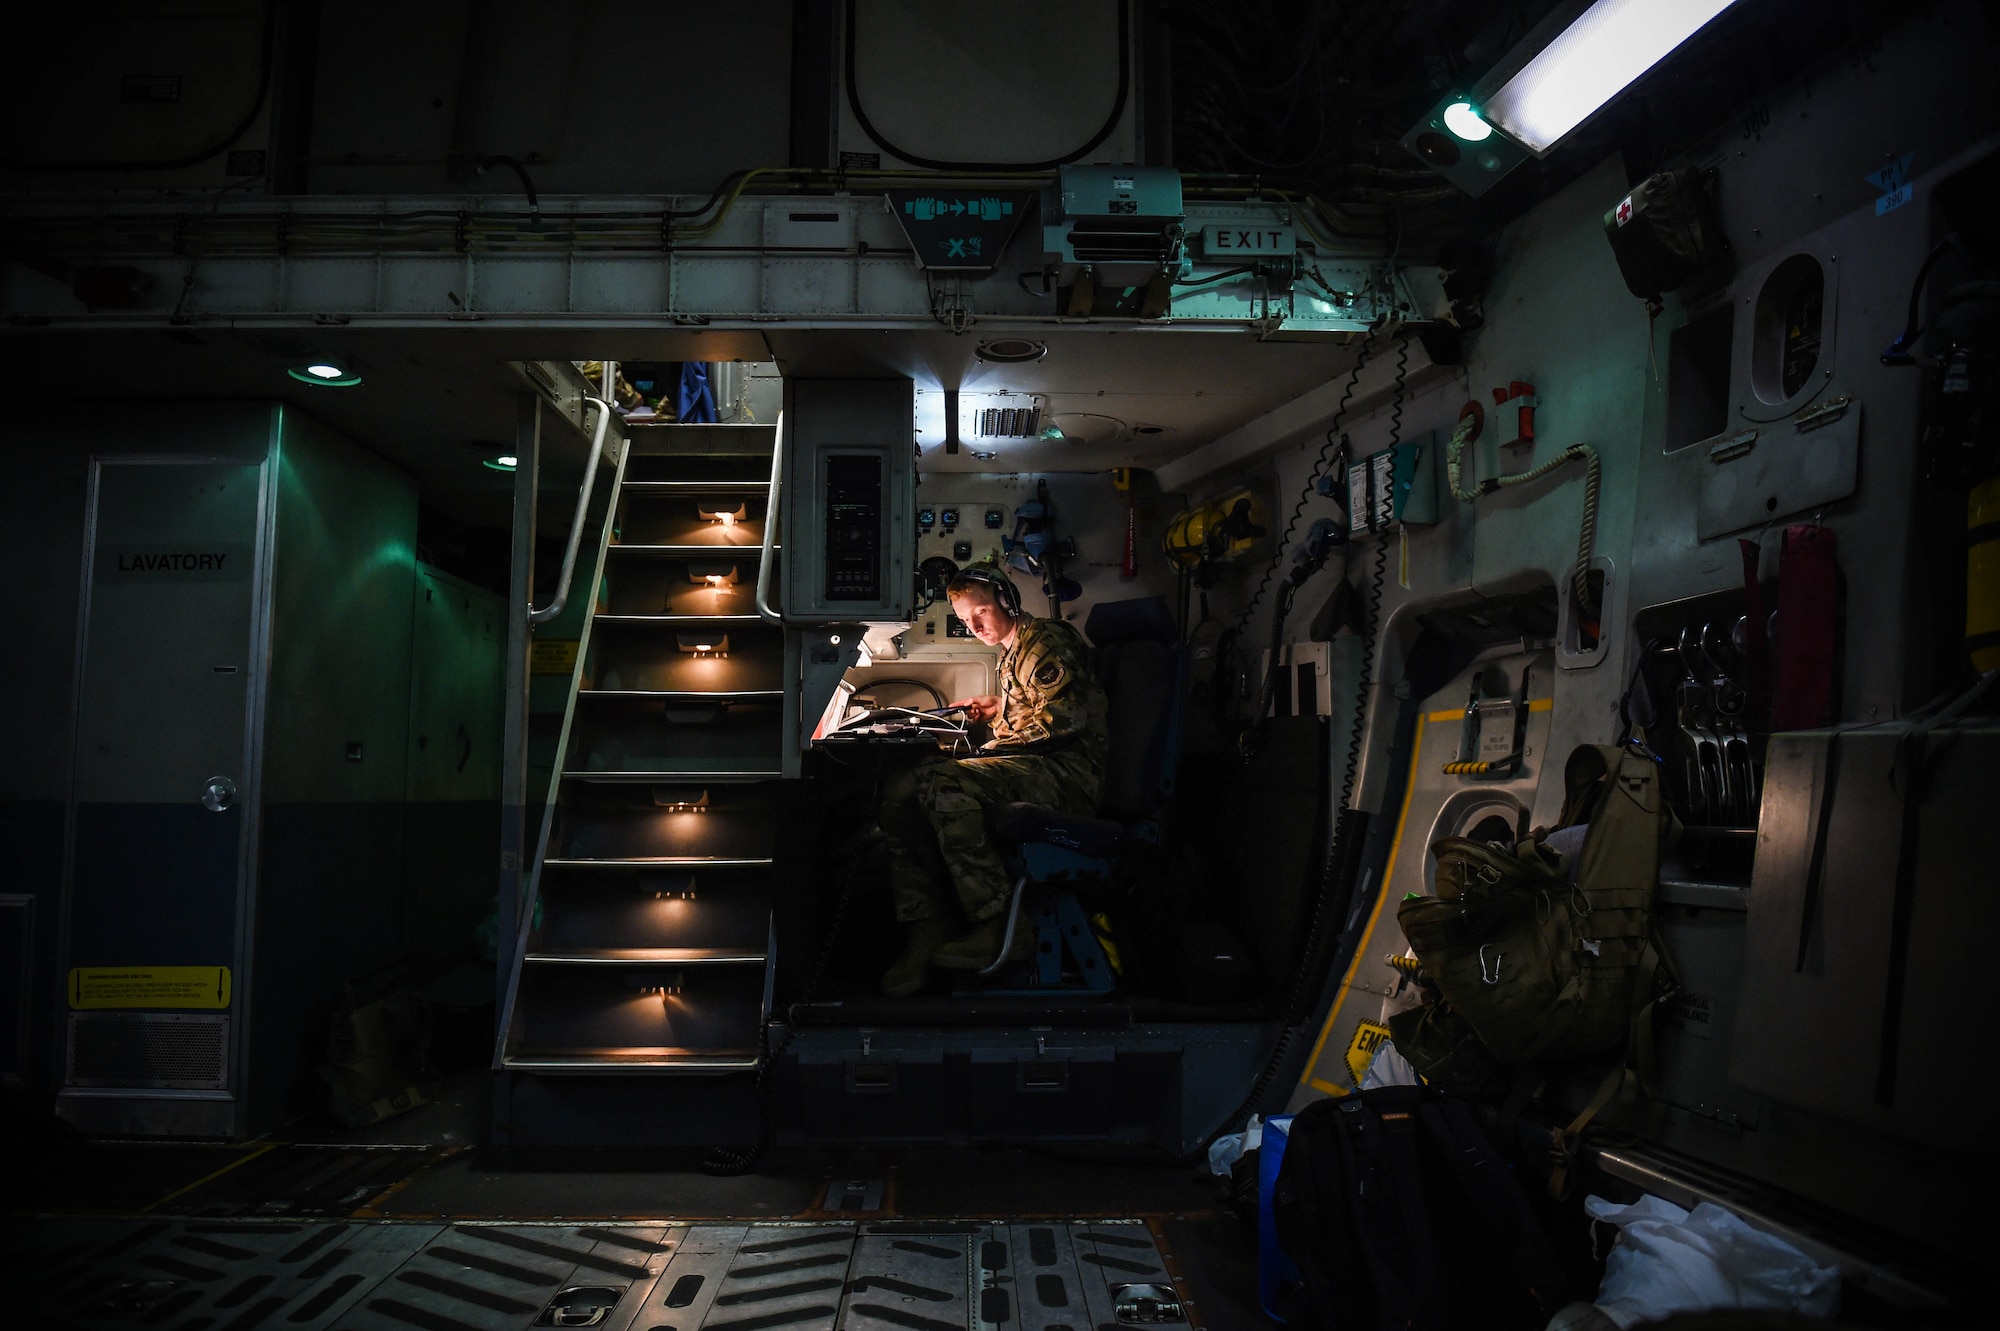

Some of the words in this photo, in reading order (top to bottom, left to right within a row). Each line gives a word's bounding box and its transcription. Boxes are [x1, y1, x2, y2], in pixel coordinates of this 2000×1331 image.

[1885, 190, 1904, 210] 390
[1217, 231, 1282, 249] EXIT
[118, 553, 227, 571] LAVATORY
